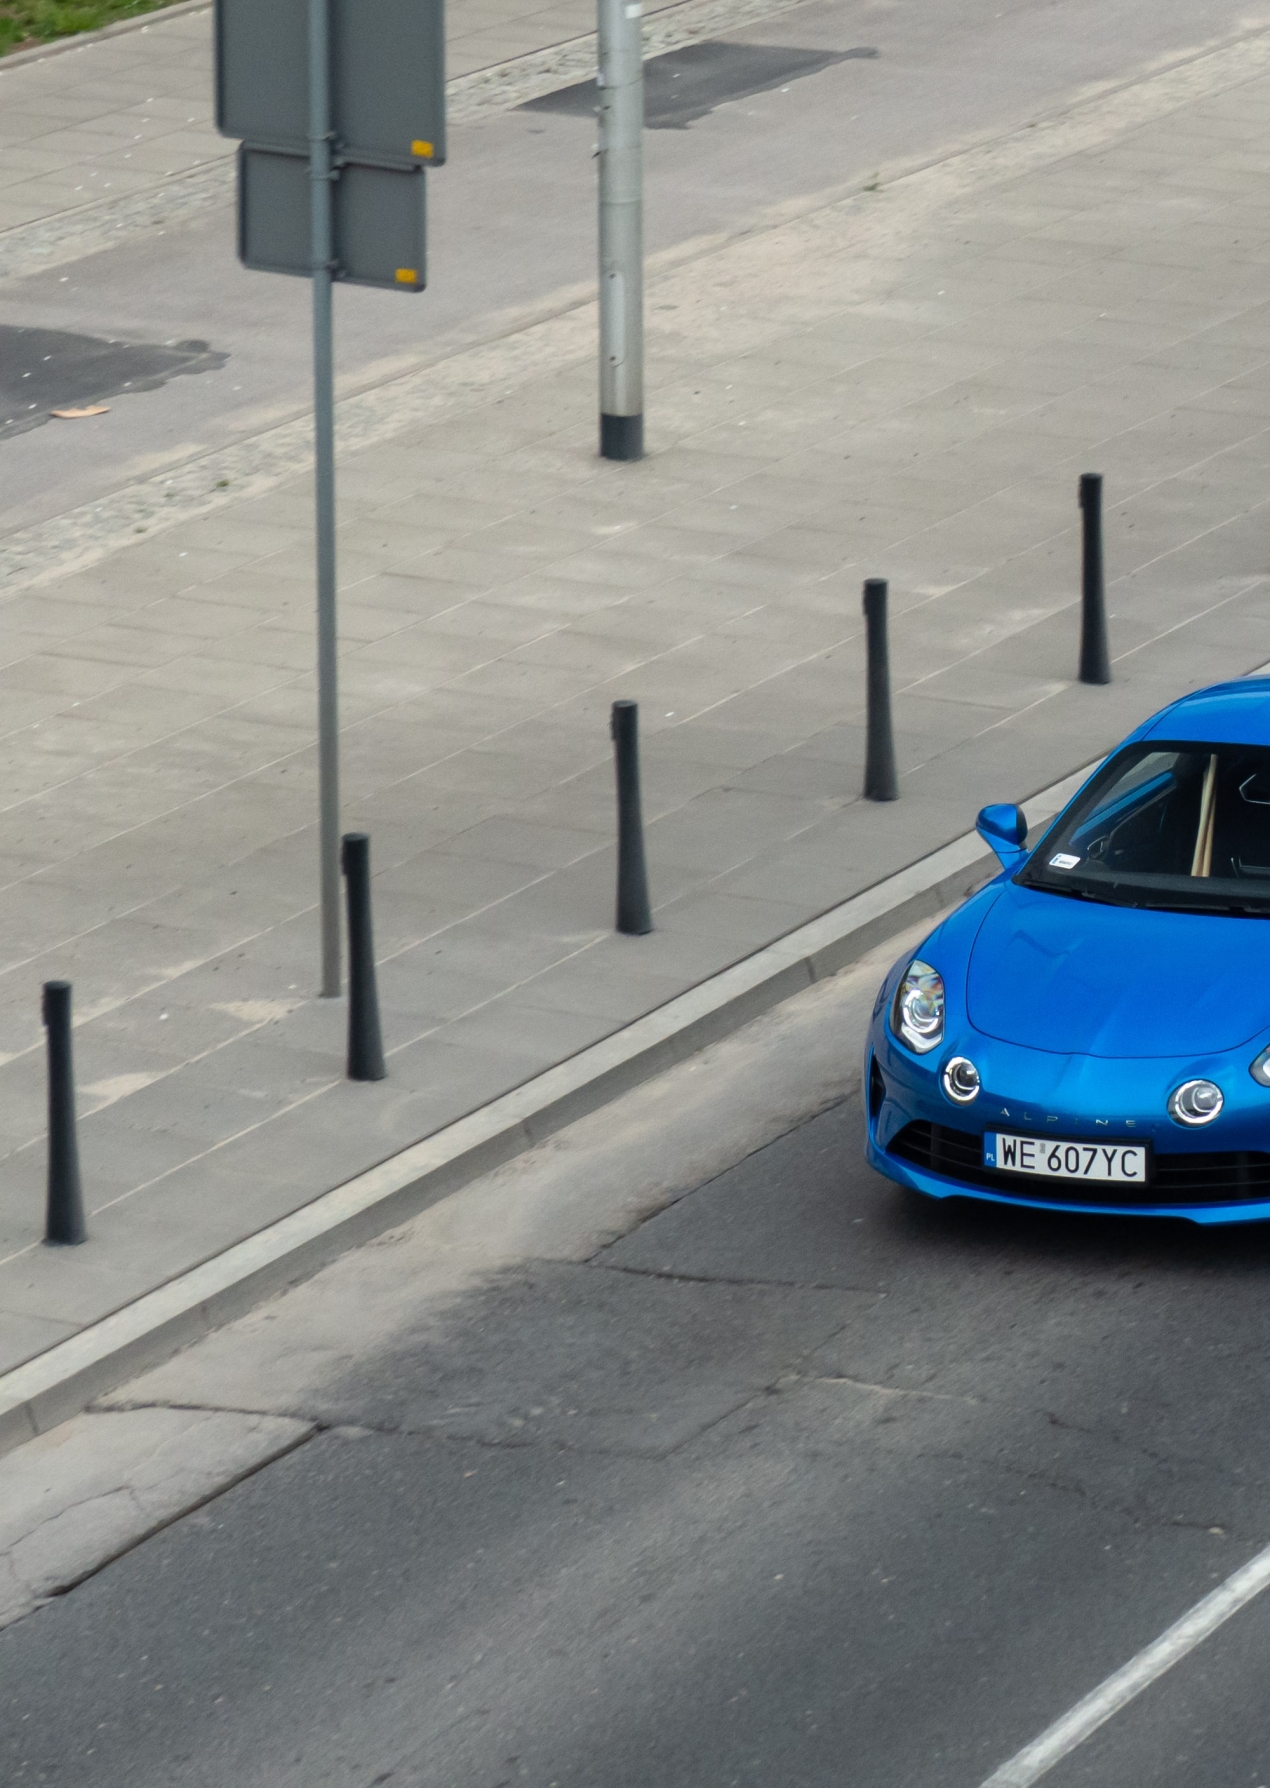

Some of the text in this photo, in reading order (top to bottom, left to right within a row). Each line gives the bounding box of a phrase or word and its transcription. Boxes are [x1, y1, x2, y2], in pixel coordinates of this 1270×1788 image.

[1000, 1107, 1137, 1128] ALPINE
[986, 1152, 995, 1162] PL
[1002, 1137, 1138, 1177] WE 607YC
